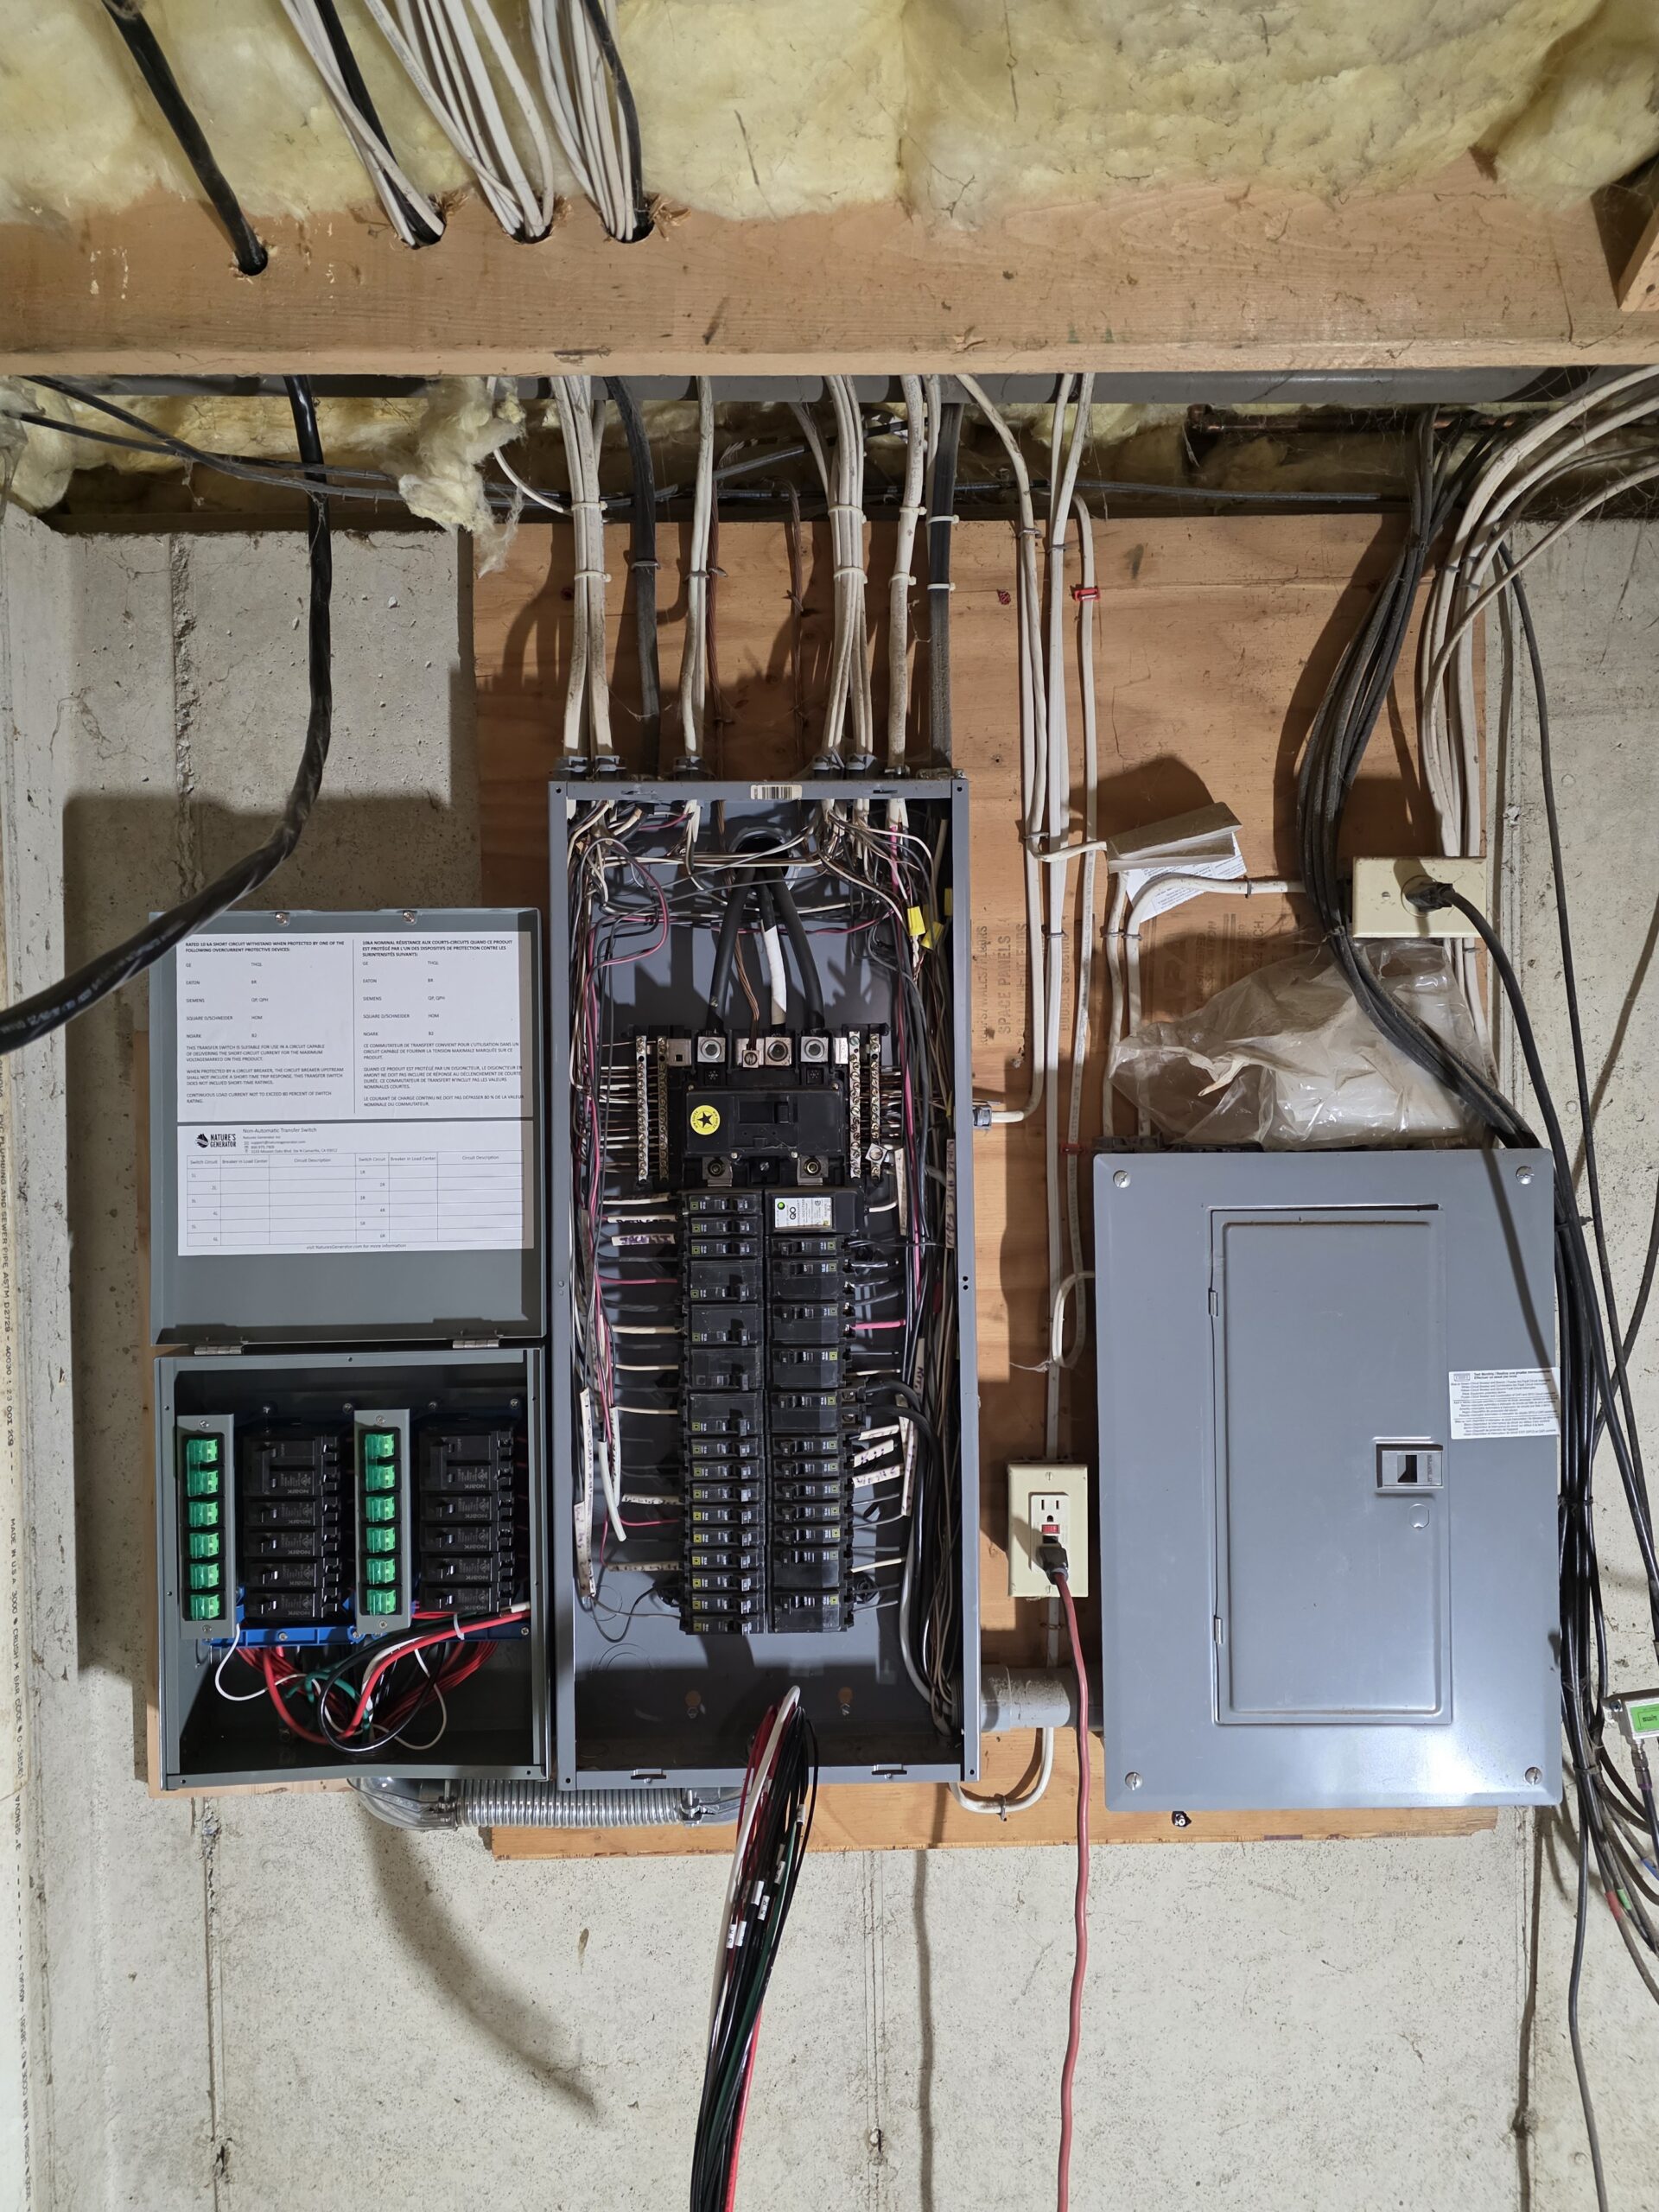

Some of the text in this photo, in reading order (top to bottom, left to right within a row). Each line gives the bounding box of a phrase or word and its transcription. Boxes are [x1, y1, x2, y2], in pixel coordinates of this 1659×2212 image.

[997, 935, 1011, 1034] SPACE PANELS
[12, 1549, 16, 1558] IN
